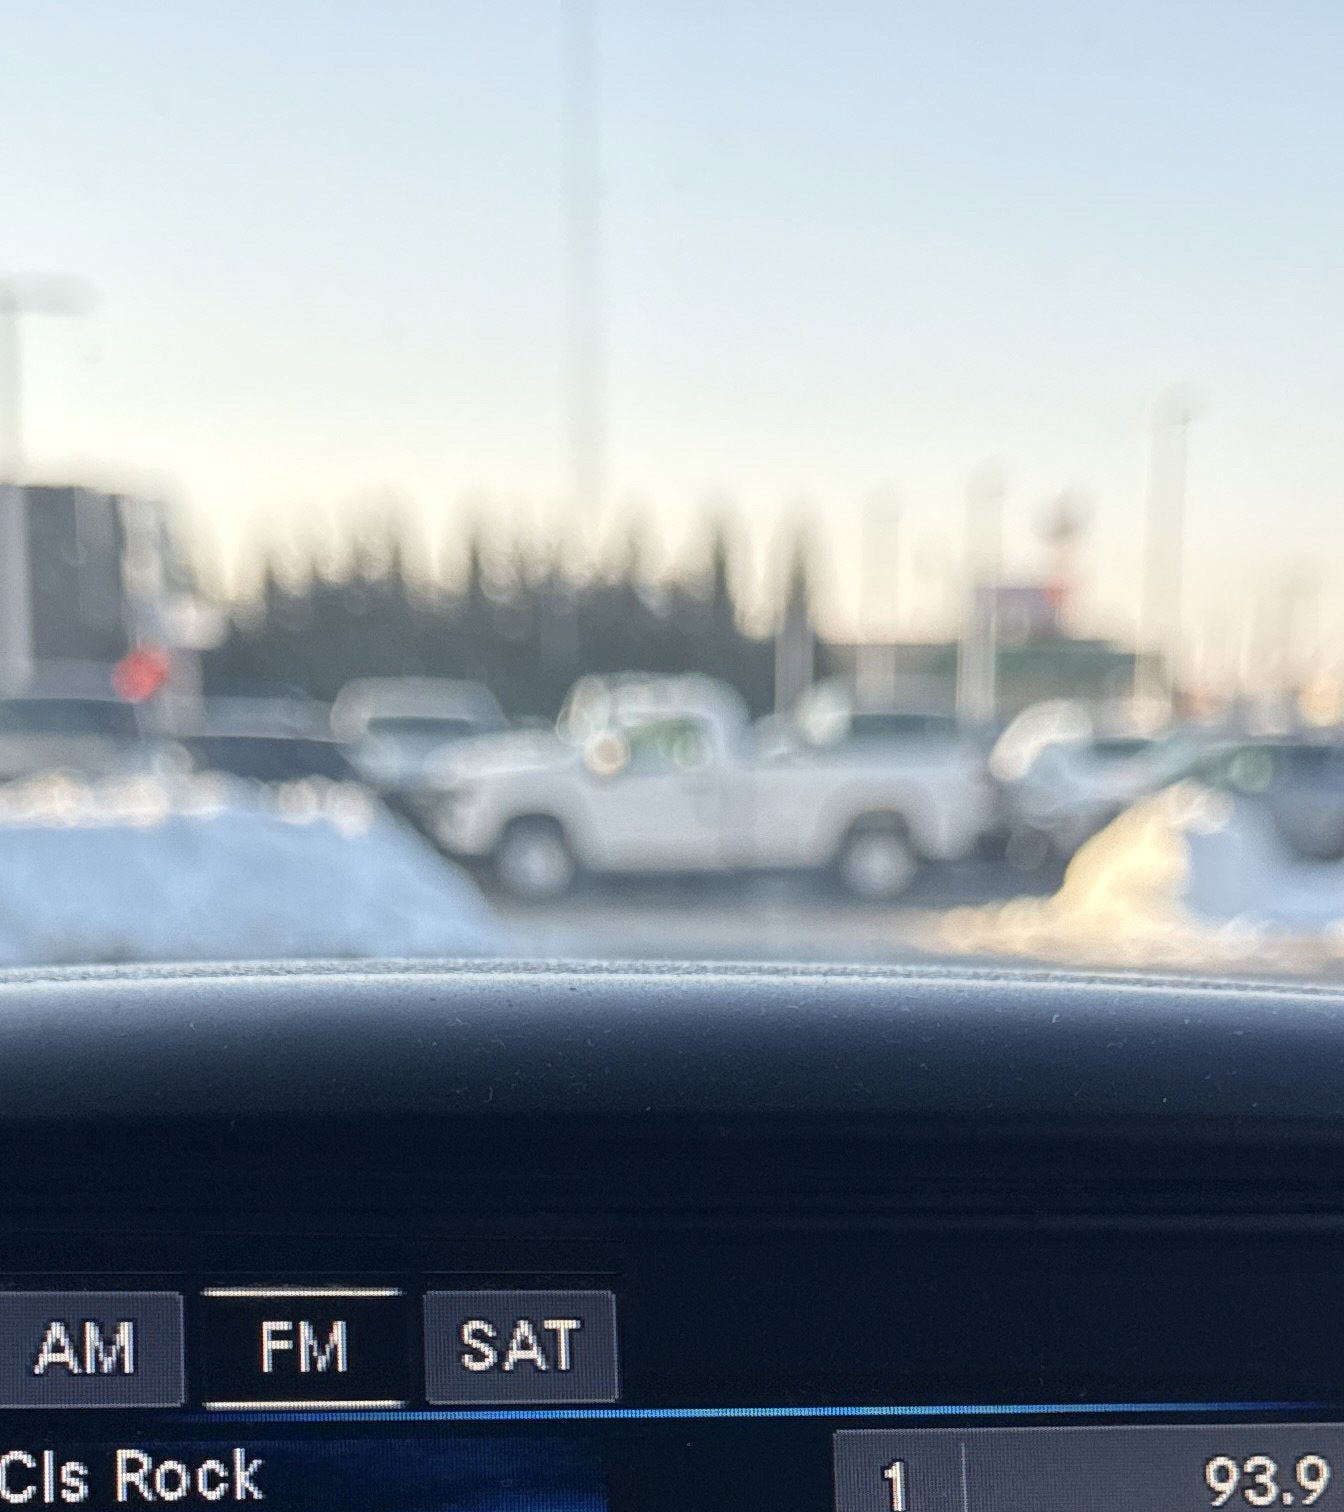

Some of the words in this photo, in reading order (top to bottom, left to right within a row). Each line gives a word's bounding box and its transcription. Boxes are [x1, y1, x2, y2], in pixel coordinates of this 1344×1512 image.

[34, 1321, 134, 1376] AM
[260, 1320, 349, 1374] FM
[461, 1318, 581, 1372] SAT
[116, 1448, 265, 1502] Rock
[882, 1461, 908, 1512] 1
[1204, 1455, 1332, 1506] 93.9
